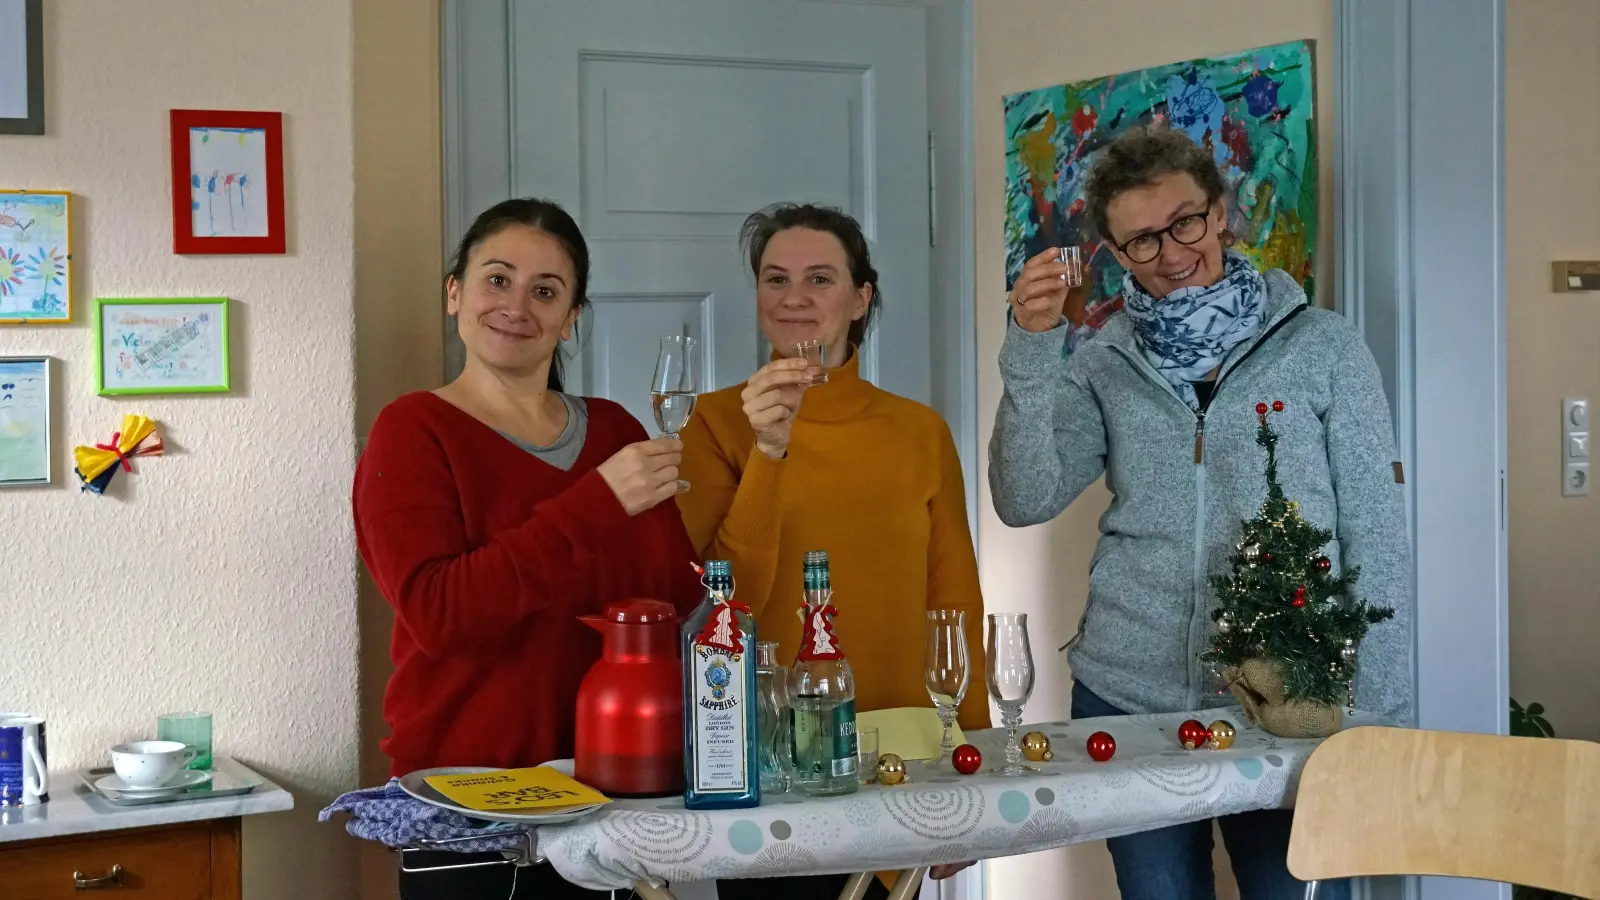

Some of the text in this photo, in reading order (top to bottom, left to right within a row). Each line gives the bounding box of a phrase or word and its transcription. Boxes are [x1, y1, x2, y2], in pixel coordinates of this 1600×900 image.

[700, 646, 732, 662] BOMBAY
[699, 695, 738, 711] SAPPHIRE
[482, 786, 552, 799] BAR
